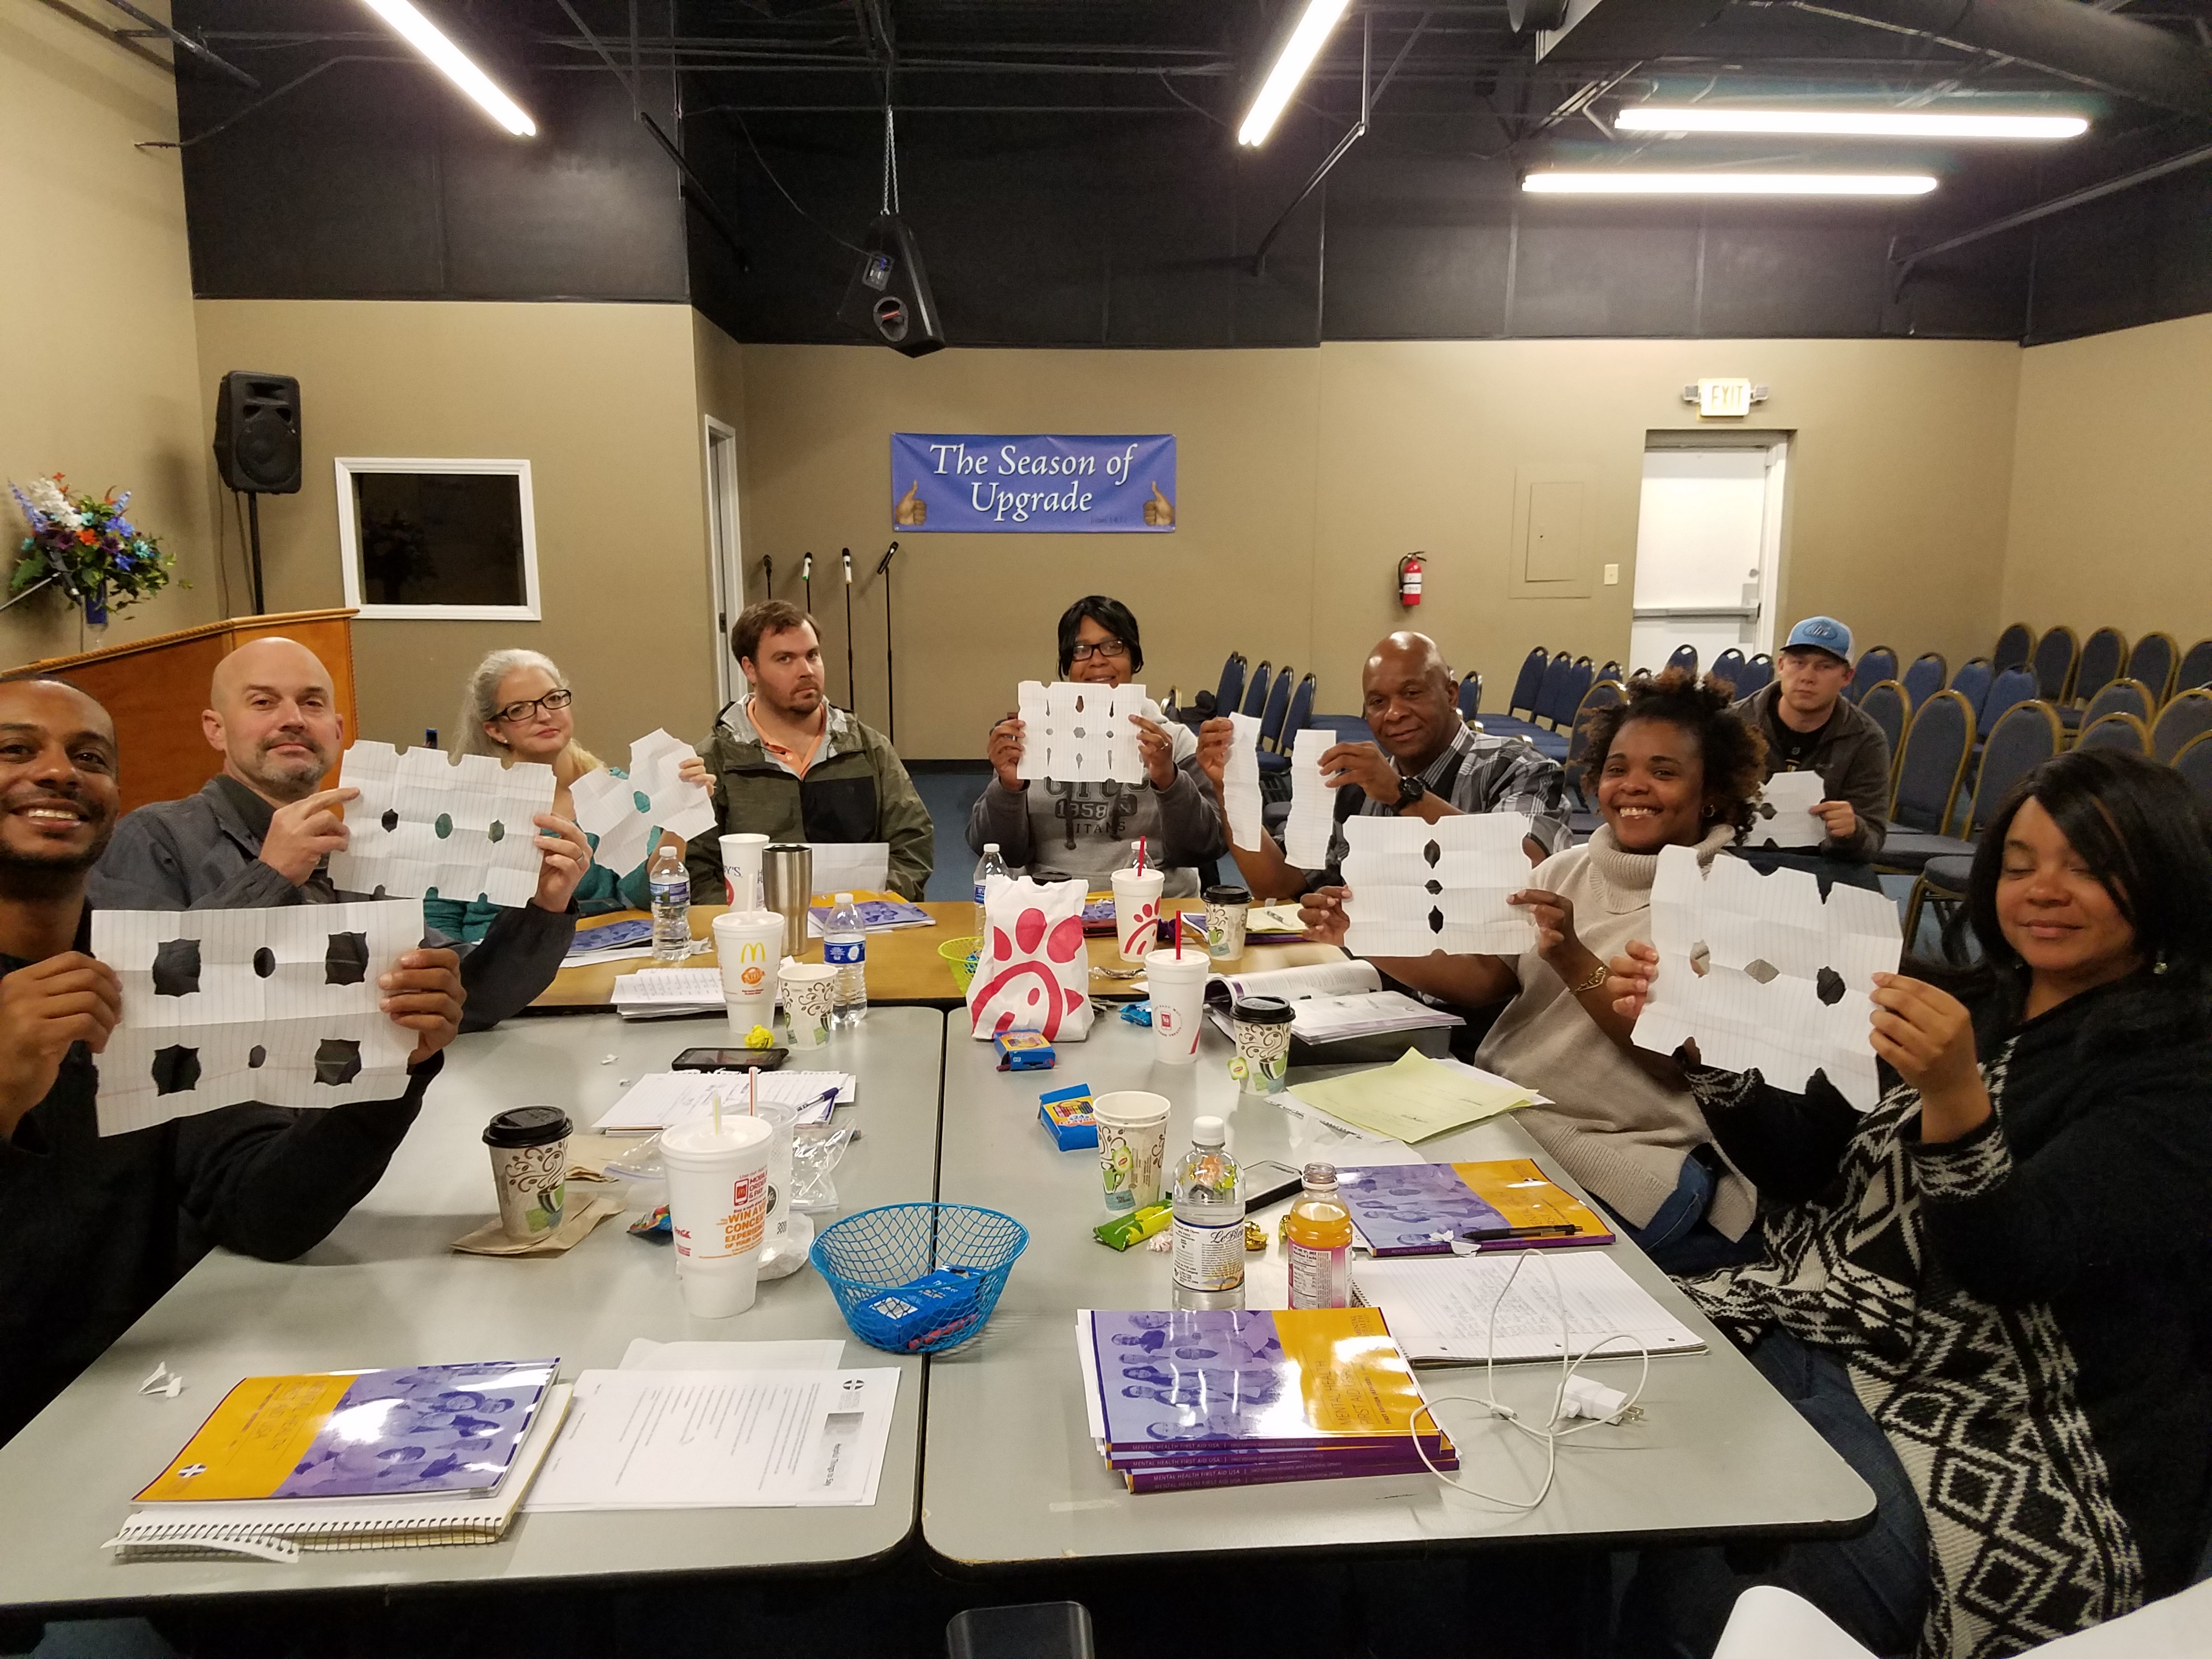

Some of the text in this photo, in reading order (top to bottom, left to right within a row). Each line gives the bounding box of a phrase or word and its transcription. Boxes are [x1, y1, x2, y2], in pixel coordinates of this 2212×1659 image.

[1711, 385, 1743, 409] EXIT
[929, 443, 1138, 486] The Season of
[970, 481, 1093, 522] Upgrade
[728, 1209, 751, 1223] WIN
[752, 1207, 758, 1216] A
[1315, 1361, 1352, 1425] MENTAL HEALTH
[1346, 1388, 1362, 1402] AID
[1353, 1404, 1374, 1425] FIRST
